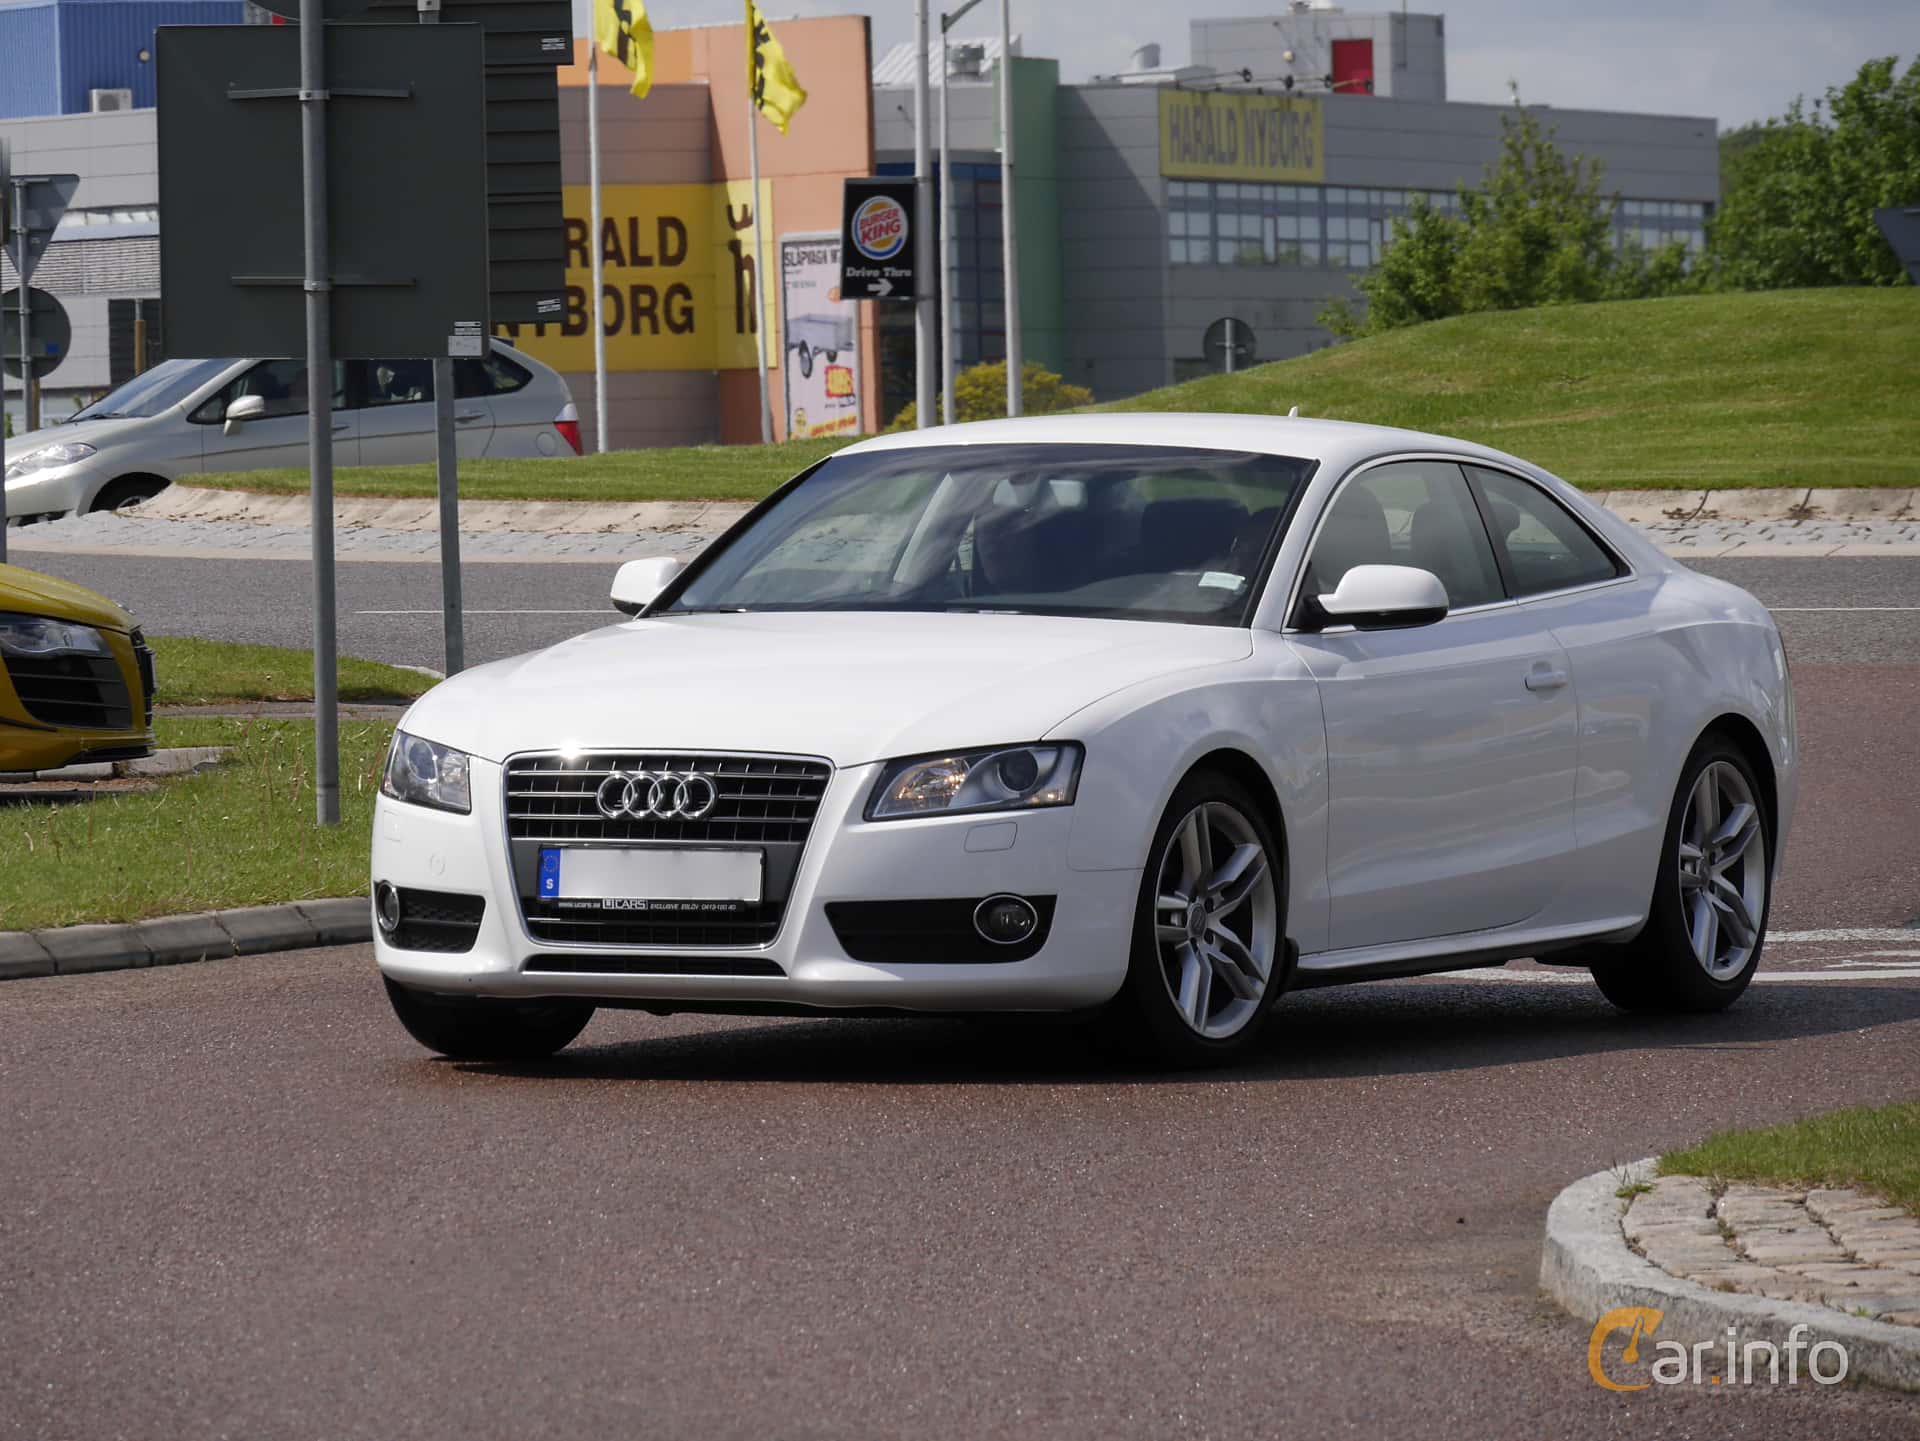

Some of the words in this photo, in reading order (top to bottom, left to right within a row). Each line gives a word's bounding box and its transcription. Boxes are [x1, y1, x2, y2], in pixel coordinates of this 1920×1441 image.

[1169, 104, 1238, 165] HARALD
[1244, 107, 1316, 169] NYBORG
[860, 207, 900, 230] BURGER
[563, 216, 689, 268] RALD
[861, 219, 901, 245] KING
[846, 267, 880, 277] Drive
[883, 266, 912, 277] Thru
[546, 878, 554, 890] S
